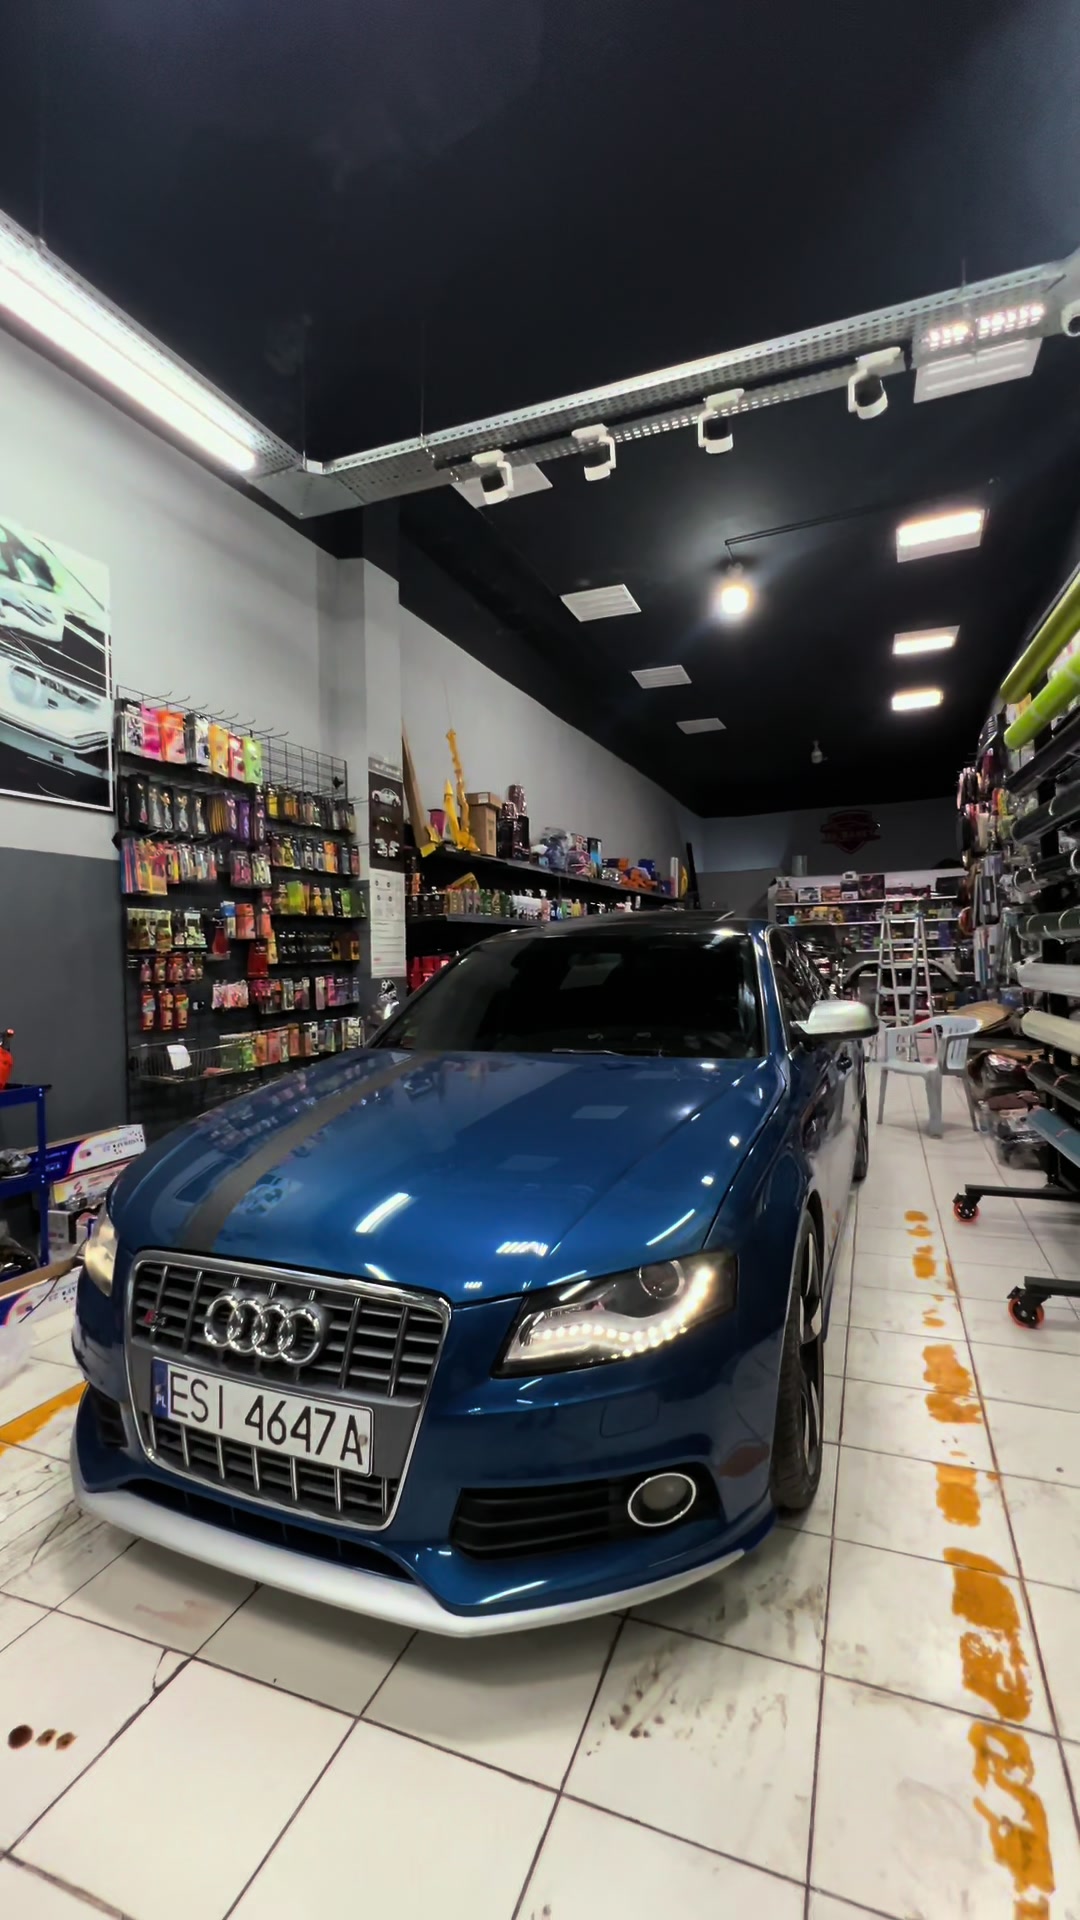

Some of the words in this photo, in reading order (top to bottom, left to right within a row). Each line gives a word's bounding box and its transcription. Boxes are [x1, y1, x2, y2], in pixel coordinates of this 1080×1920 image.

[155, 1393, 167, 1408] PL
[170, 1370, 223, 1430] ESI
[244, 1395, 363, 1466] 4647A
